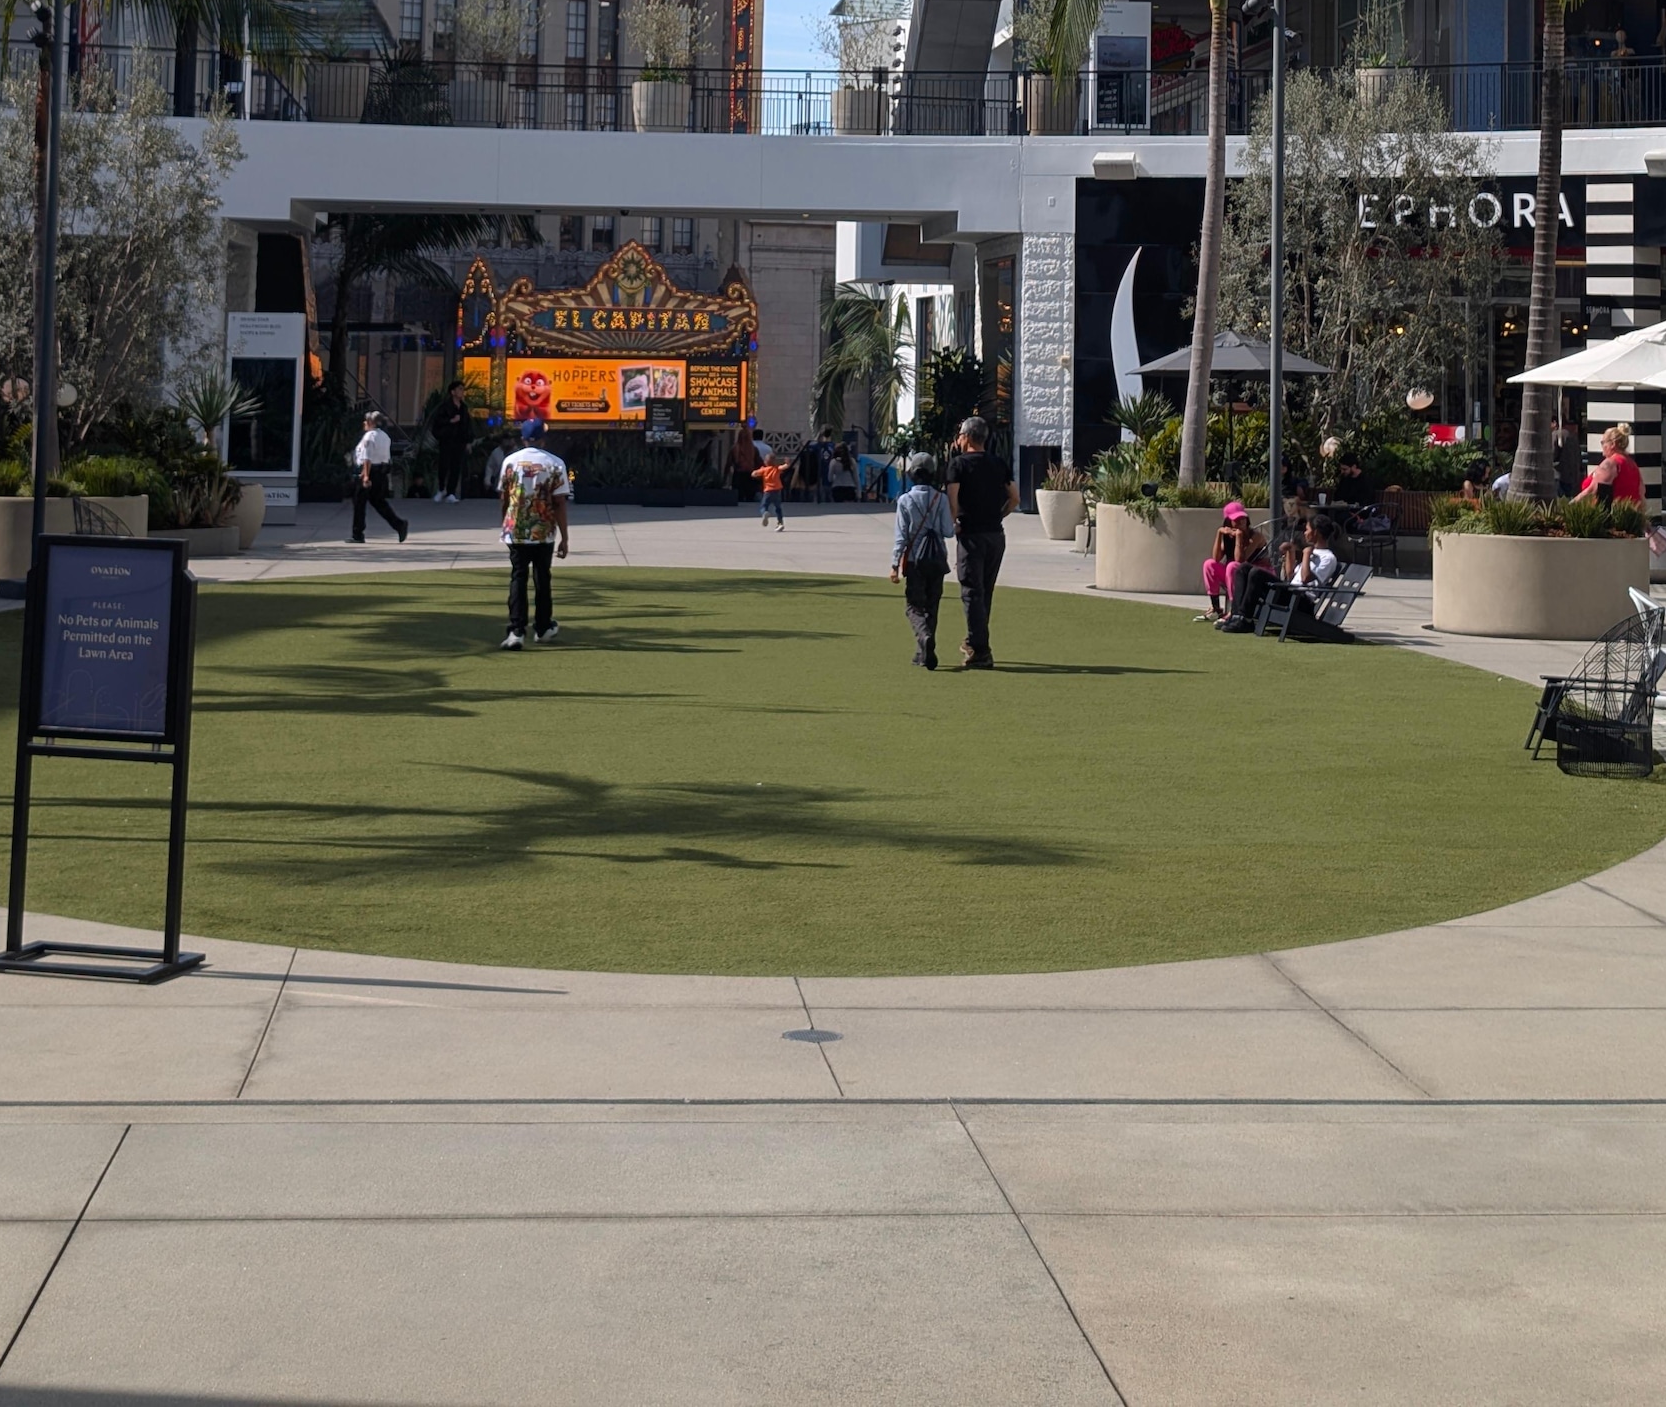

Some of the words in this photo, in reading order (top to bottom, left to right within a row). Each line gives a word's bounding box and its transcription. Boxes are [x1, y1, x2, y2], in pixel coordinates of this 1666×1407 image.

[1358, 192, 1575, 229] EPHORA
[553, 309, 583, 329] EL
[591, 309, 710, 331] CAPITAN
[553, 370, 616, 383] HOPPERS
[690, 377, 737, 387] SHOWCASE
[690, 387, 701, 396] OF
[702, 387, 737, 396] ANIMALS
[265, 490, 290, 499] ATION
[91, 565, 131, 576] OVATION
[93, 602, 126, 610] PLEASE:
[58, 614, 74, 625] No
[76, 614, 99, 626] Pets
[101, 617, 113, 627] or
[115, 617, 159, 629] Animals
[63, 630, 115, 644] Permitted
[118, 634, 132, 644] on
[134, 634, 152, 645] the
[79, 647, 107, 659] Lawn
[108, 649, 134, 660] Area
